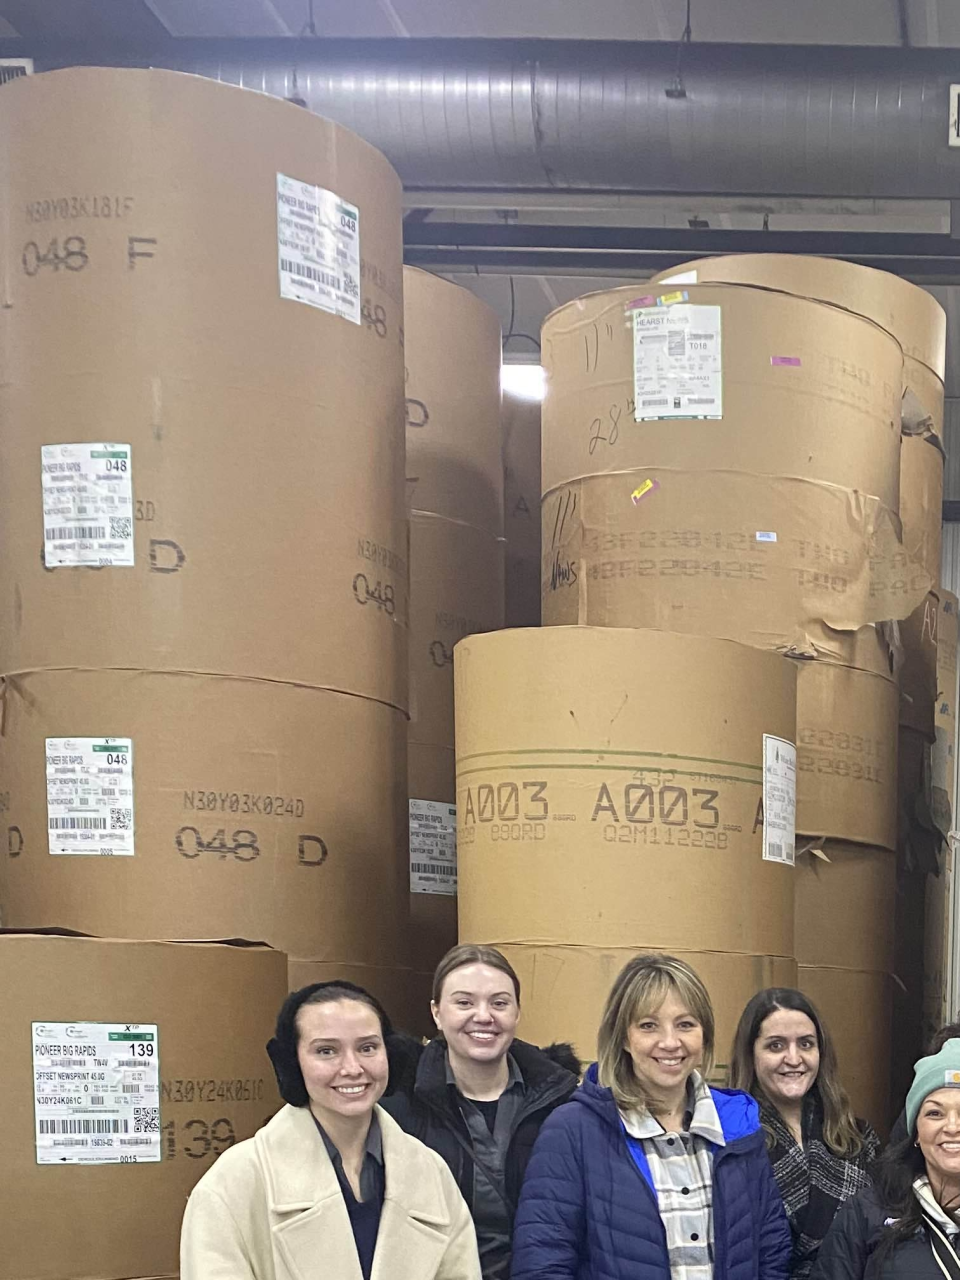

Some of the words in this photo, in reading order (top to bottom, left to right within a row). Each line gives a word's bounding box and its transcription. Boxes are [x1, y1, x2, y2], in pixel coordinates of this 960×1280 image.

[340, 215, 356, 233] 048
[22, 236, 89, 276] 048
[128, 236, 157, 270] F
[636, 318, 664, 327] HEARST
[689, 342, 708, 350] T018
[106, 460, 127, 472] 048
[149, 538, 186, 574] D
[353, 573, 395, 615] 048
[107, 753, 128, 765] 048
[464, 781, 549, 825] A003
[591, 782, 719, 829] A003
[175, 826, 260, 861] 048
[298, 834, 328, 866] D
[35, 1044, 61, 1056] PIONEER
[63, 1045, 73, 1057] BIG
[75, 1045, 96, 1057] RAPIDS
[129, 1043, 154, 1057] 139
[36, 1072, 56, 1080] OFFSET
[58, 1072, 89, 1080] NEWSPRINT
[119, 1155, 137, 1163] 0015
